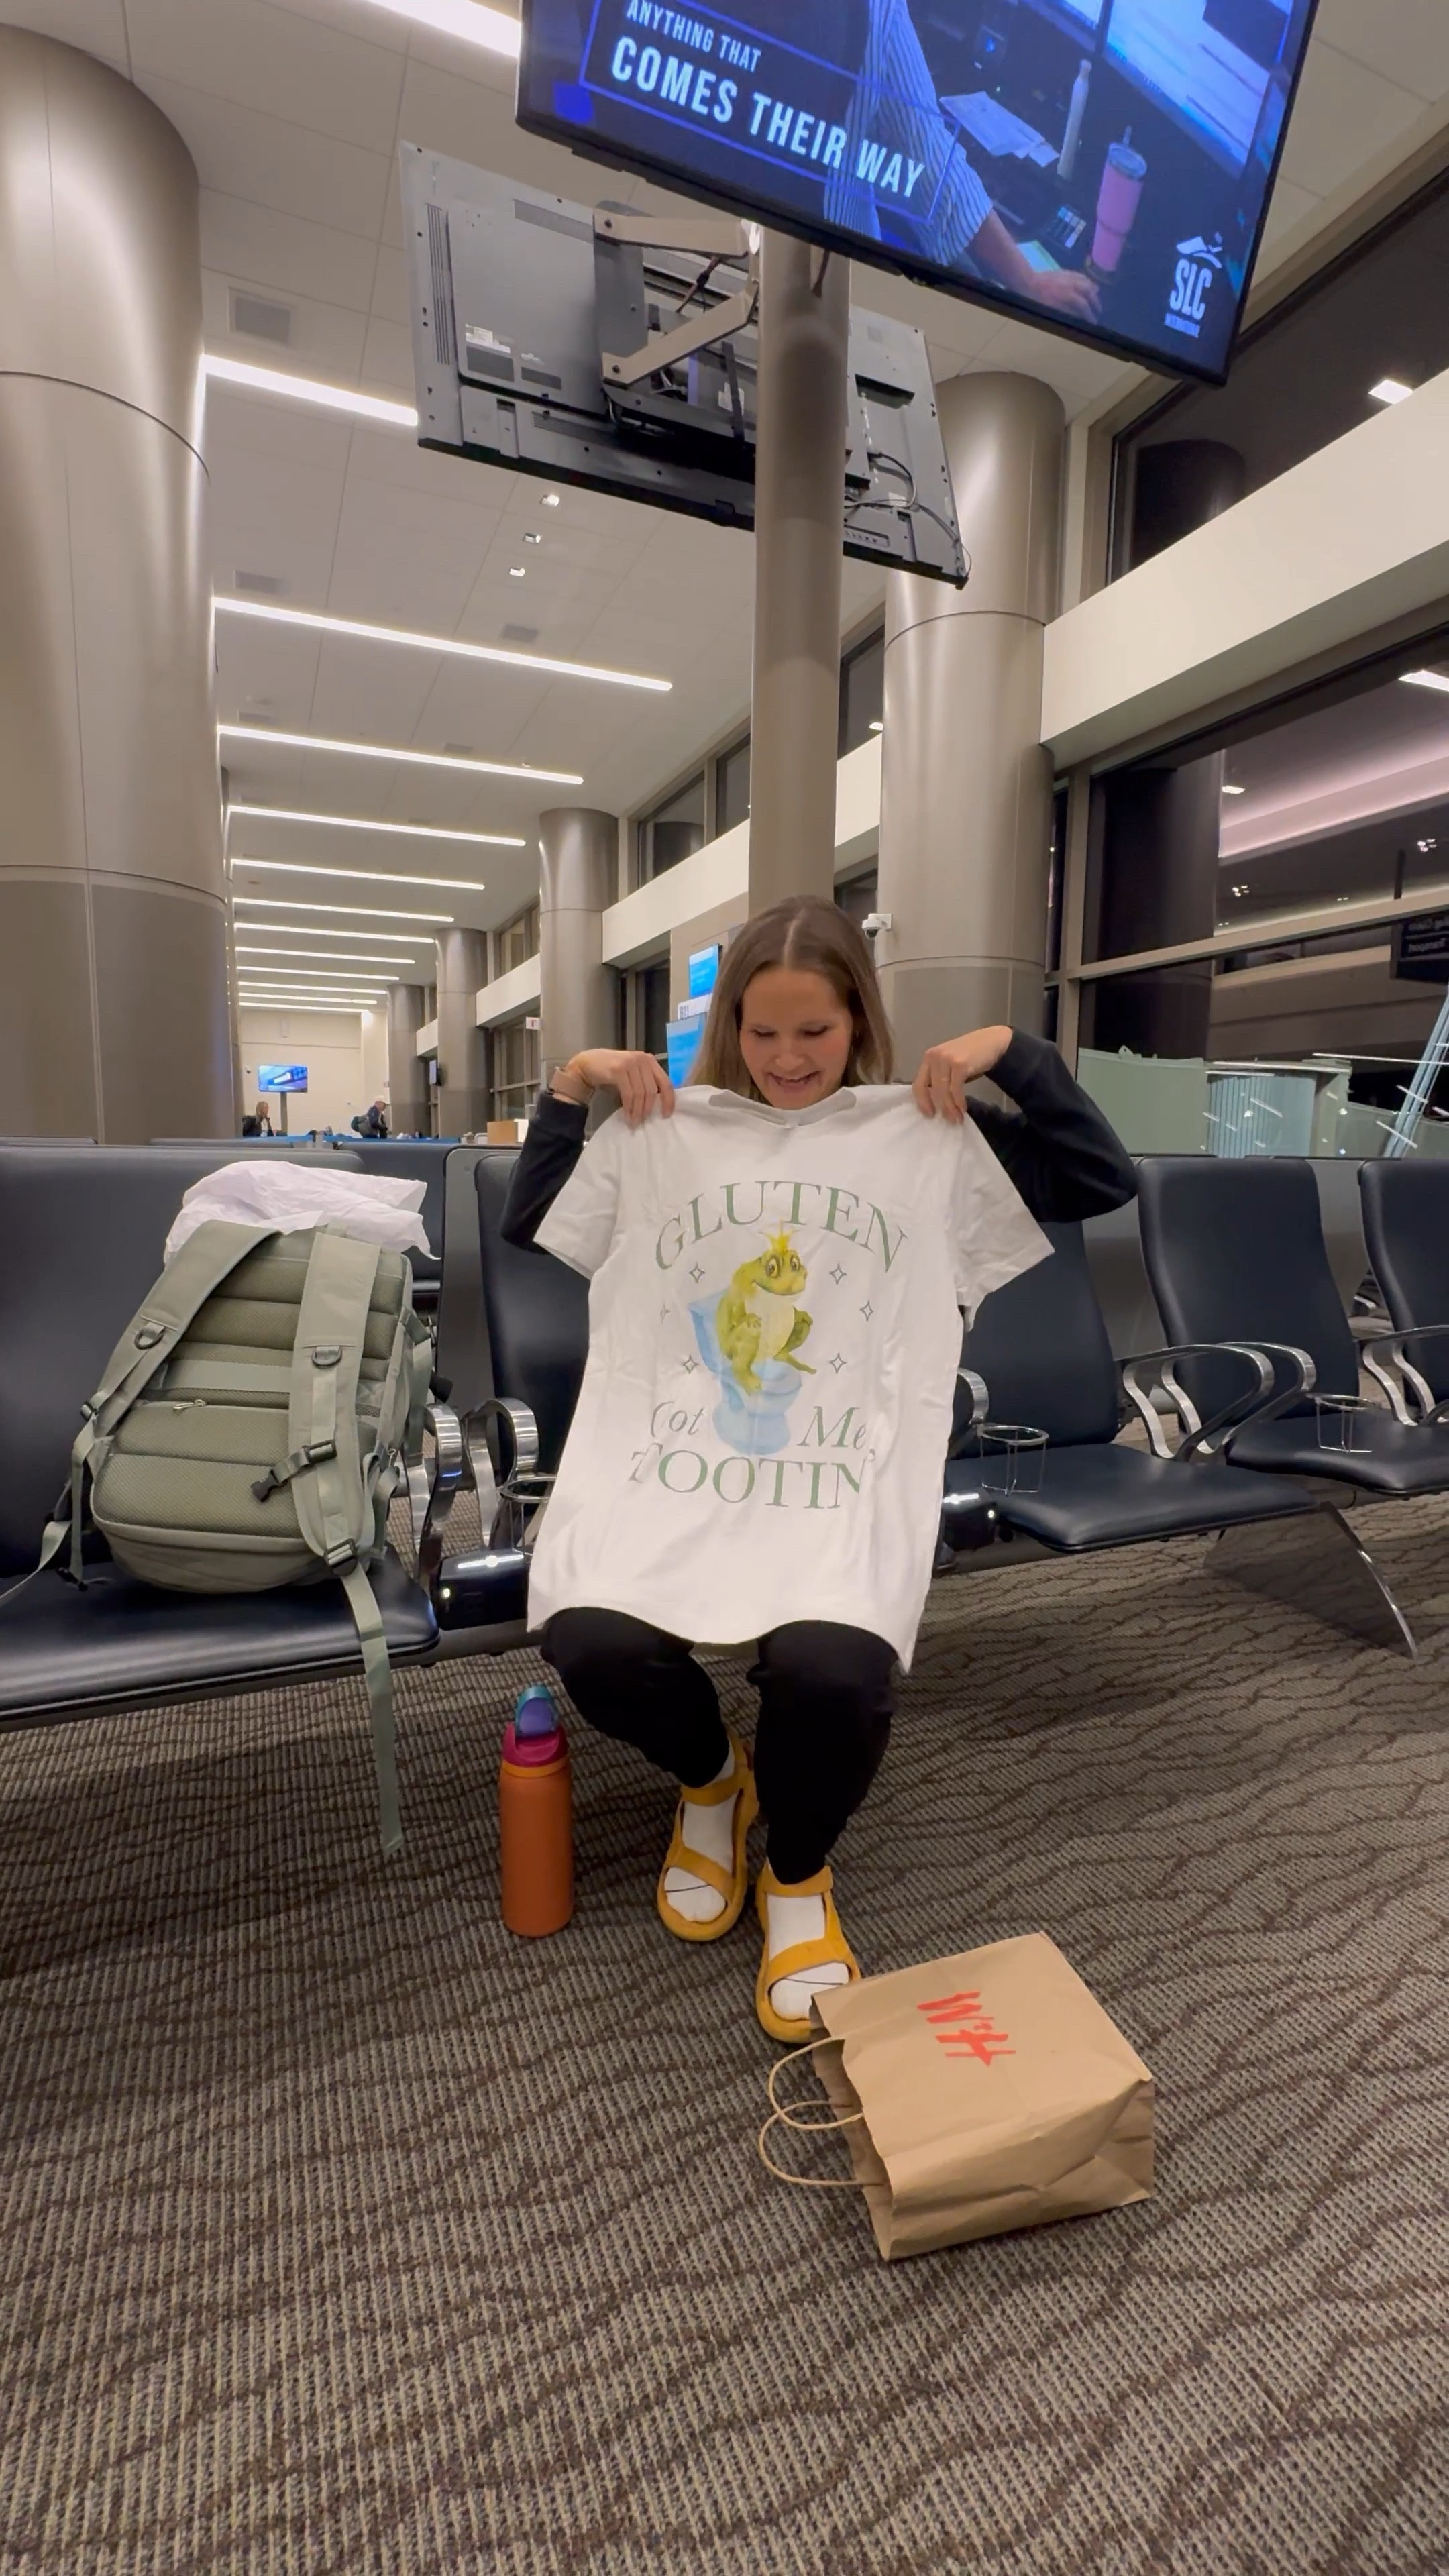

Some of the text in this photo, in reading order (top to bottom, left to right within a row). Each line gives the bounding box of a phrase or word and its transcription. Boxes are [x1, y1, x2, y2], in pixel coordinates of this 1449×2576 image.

[627, 0, 762, 73] ANYTHING THAT
[612, 36, 925, 197] COMES THEIR WAY
[1169, 258, 1212, 320] SLC
[655, 1181, 908, 1273] GLUTEN
[797, 1405, 866, 1450] Me
